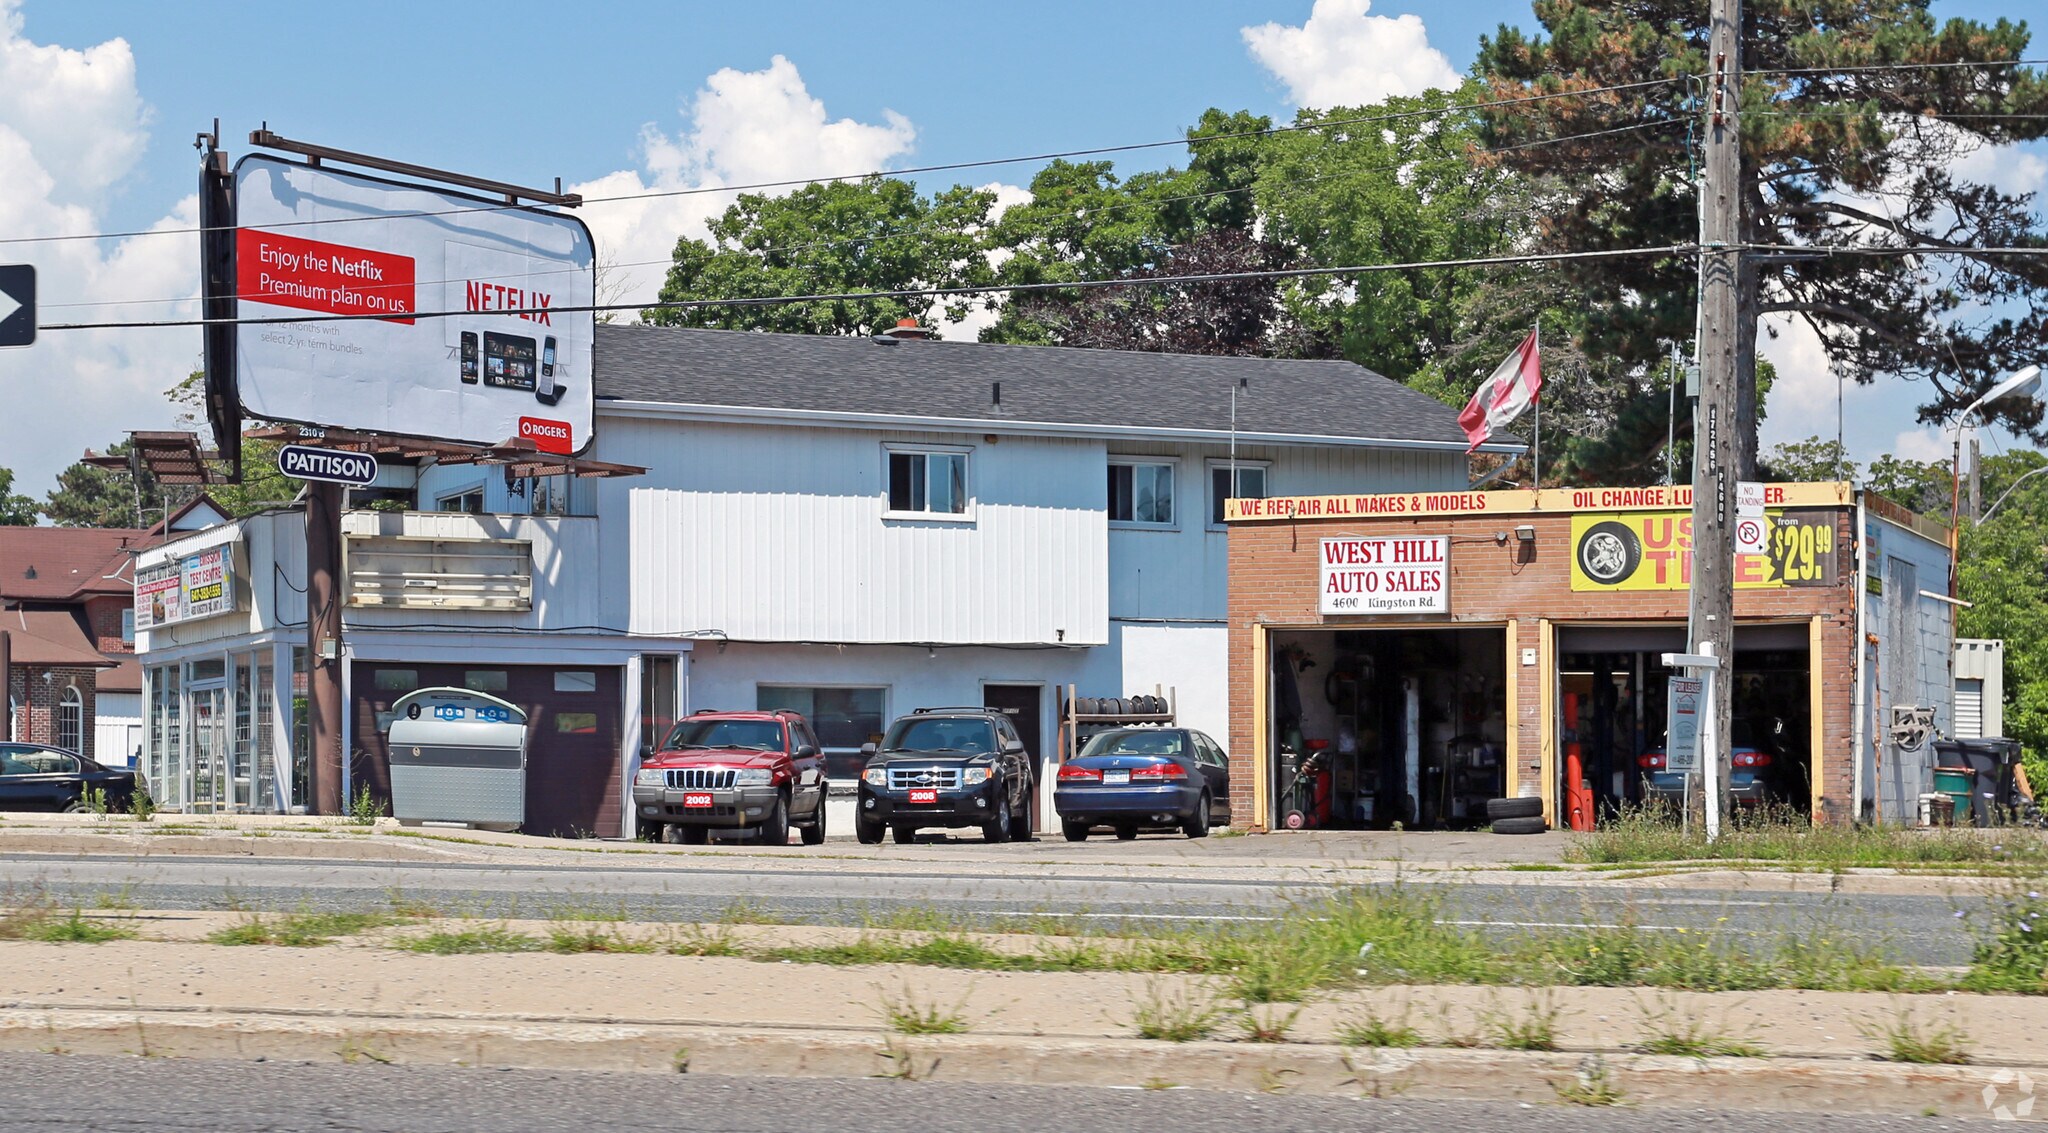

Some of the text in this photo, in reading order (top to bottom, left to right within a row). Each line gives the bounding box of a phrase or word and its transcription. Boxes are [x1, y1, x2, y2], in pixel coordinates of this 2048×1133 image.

[260, 243, 383, 281] Enjoy the Netflix
[260, 273, 408, 313] Premium plan on us.
[466, 280, 551, 327] NETFLIX
[289, 321, 320, 334] months
[322, 326, 340, 336] with
[261, 332, 285, 344] select
[308, 339, 327, 349] term
[299, 427, 317, 438] 2310
[532, 424, 567, 438] ROGERS
[287, 452, 370, 479] PATTISON
[1573, 492, 1596, 507] OIL
[1601, 489, 1664, 507] CHANGE
[1743, 487, 1754, 495] NO
[1240, 500, 1261, 516] WE
[1326, 498, 1351, 514] ALL
[1355, 496, 1406, 513] MAKES
[1411, 496, 1420, 511] &
[1426, 494, 1486, 511] MODELS
[1737, 497, 1764, 506] TANDING
[1324, 540, 1443, 564] WEST HILL
[190, 566, 222, 586] TEST CENTRE
[1326, 570, 1441, 593] AUTO SALES
[1332, 596, 1436, 610] 4600 Kingston Rd.
[1675, 682, 1700, 693] FOR LEASE
[686, 796, 711, 804] 2002
[911, 792, 935, 800] 2008
